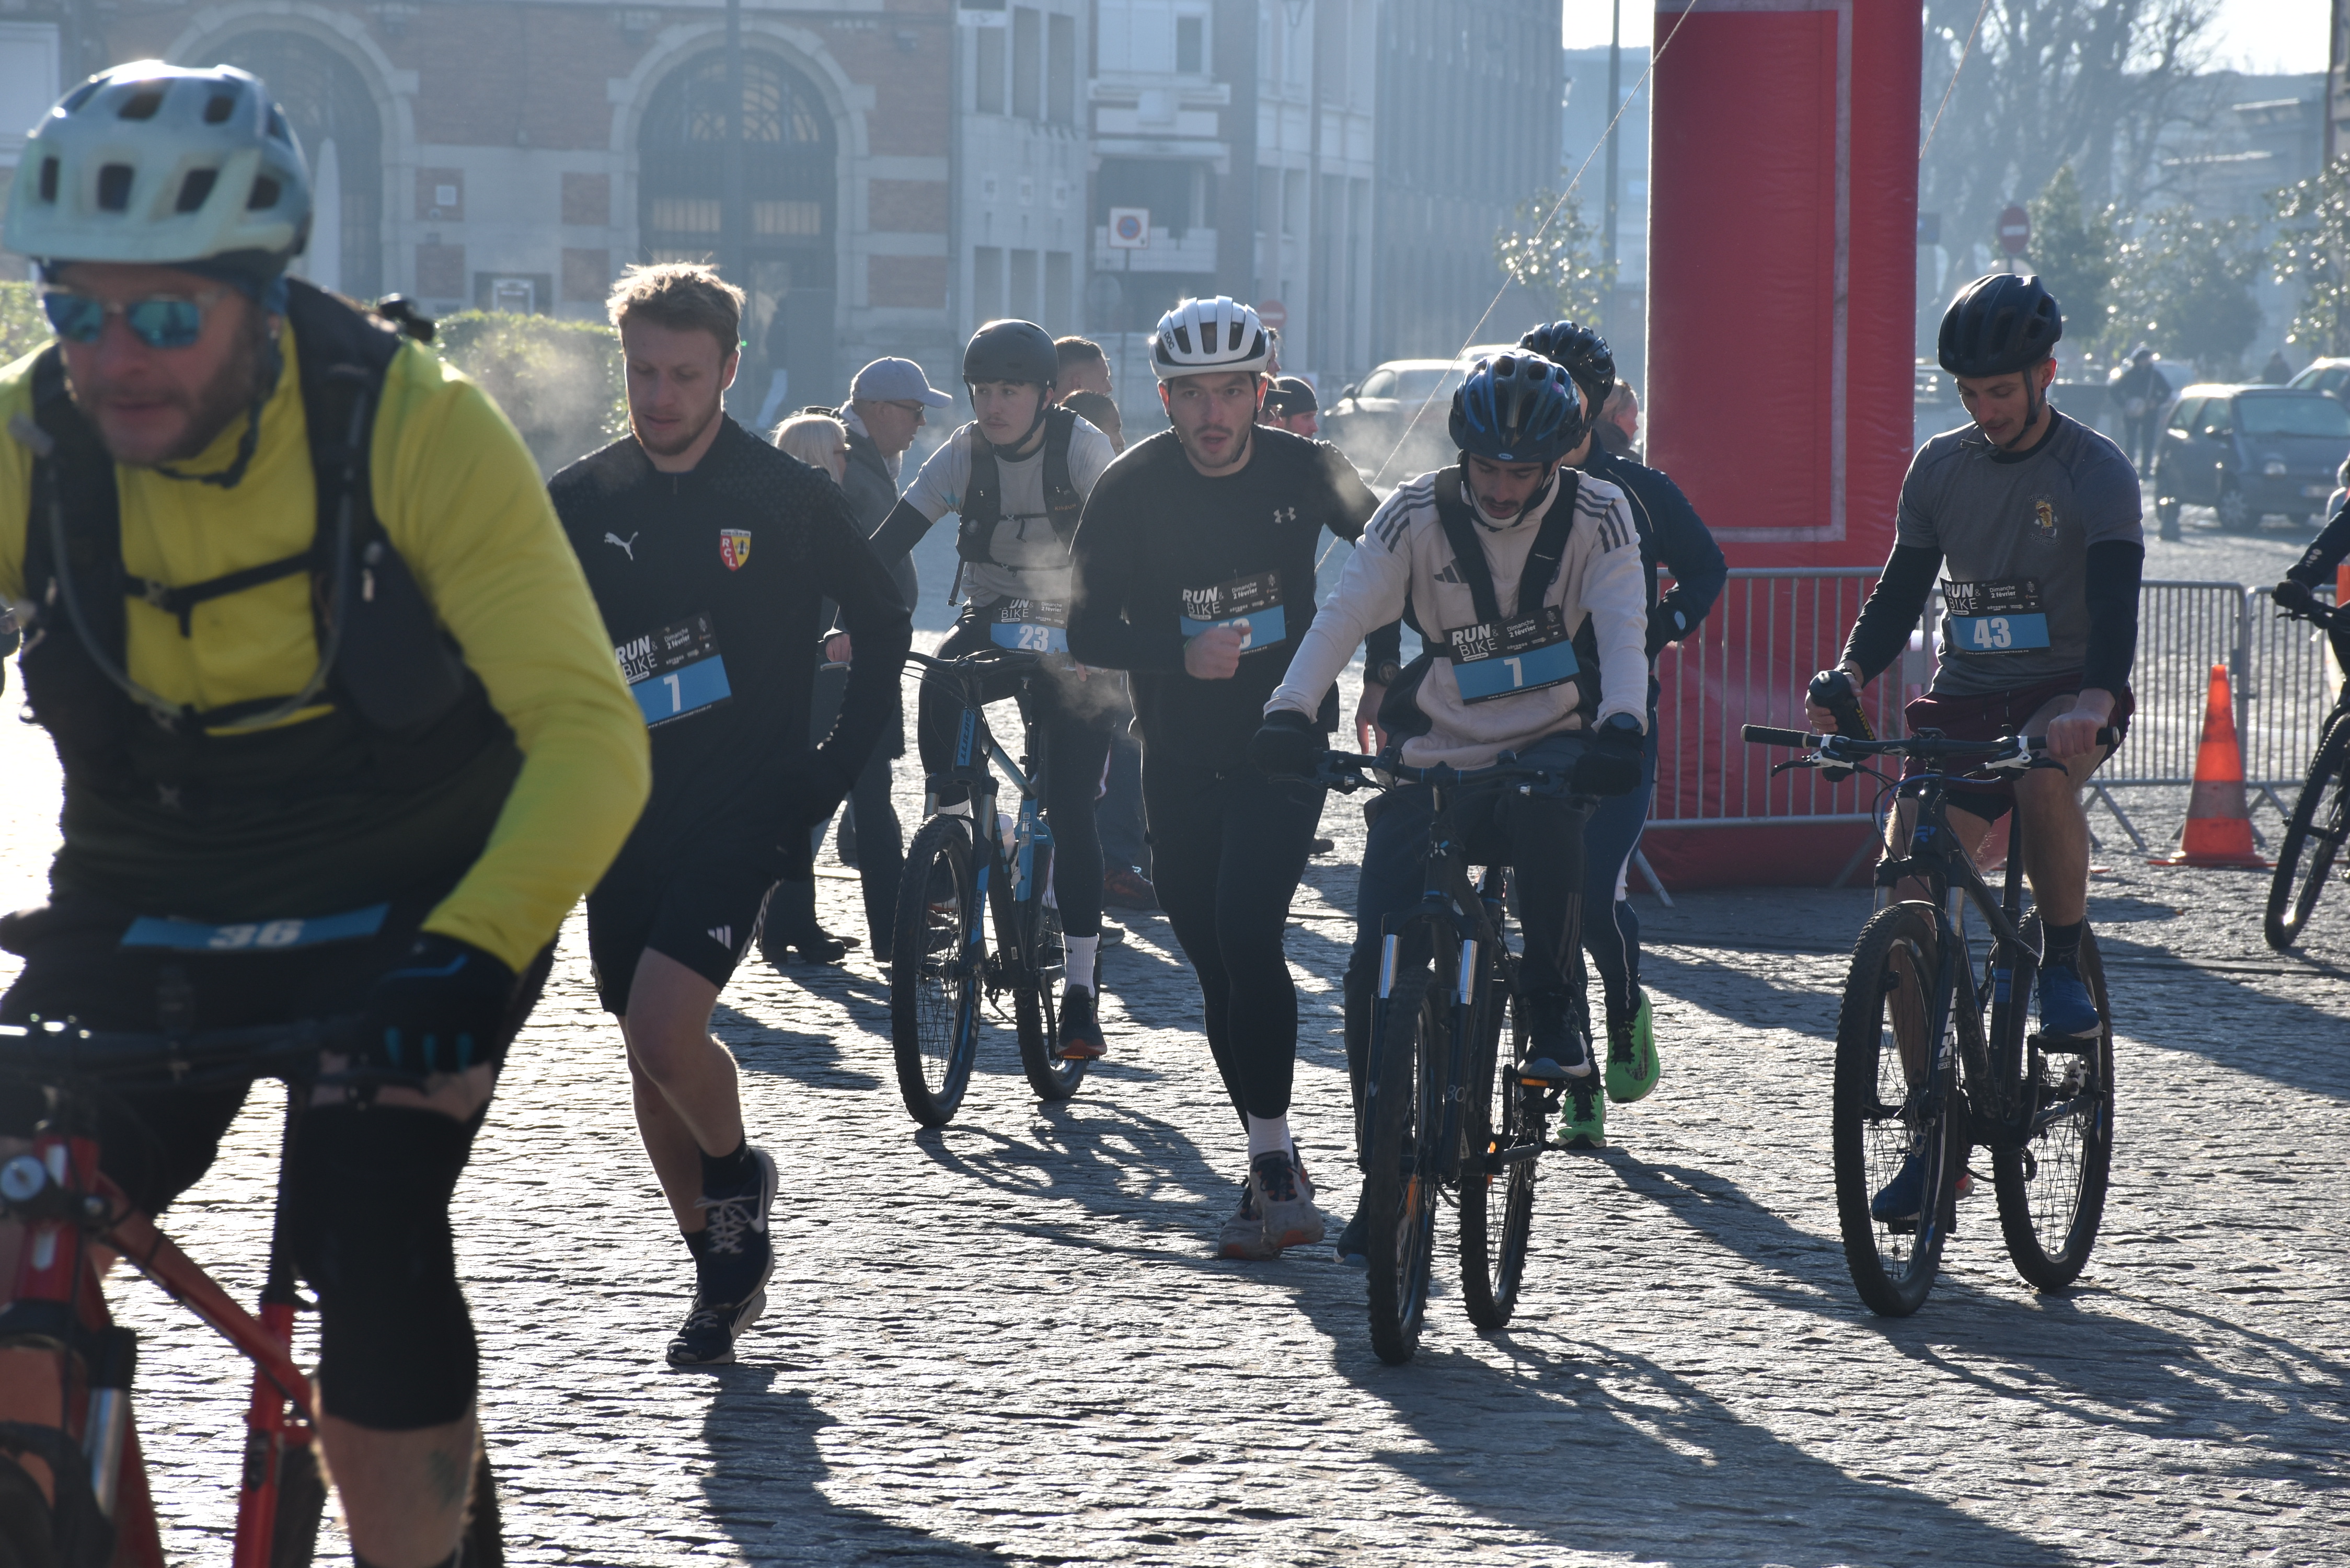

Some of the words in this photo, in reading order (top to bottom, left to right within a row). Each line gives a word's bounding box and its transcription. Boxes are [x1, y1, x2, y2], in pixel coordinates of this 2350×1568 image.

[1164, 331, 1174, 349] POC
[722, 538, 735, 567] RCL
[1182, 586, 1218, 604] RUN
[1218, 592, 1224, 601] &
[1231, 582, 1257, 594] Dimanche
[1238, 587, 1258, 598] février
[1945, 583, 1974, 598] RUN
[1001, 608, 1029, 618] BIKE
[1187, 601, 1221, 615] BIKE
[1949, 598, 1978, 610] BIKE
[1452, 624, 1490, 645] RUN
[1506, 619, 1535, 632] Dimanche
[1515, 625, 1536, 636] février
[1974, 617, 2011, 648] 43
[664, 628, 688, 642] Dimanche
[672, 635, 690, 648] février
[1018, 625, 1049, 652] 23
[615, 635, 650, 665] RUN
[652, 641, 658, 651] &
[1459, 638, 1497, 657] BIKE
[622, 652, 658, 678] BIKE
[1488, 681, 1559, 699] WWW.SPORTCHRONOMETRAGE.FR
[1856, 708, 1874, 740] MAVIC
[961, 709, 971, 764] GIANT
[207, 919, 307, 949] 36
